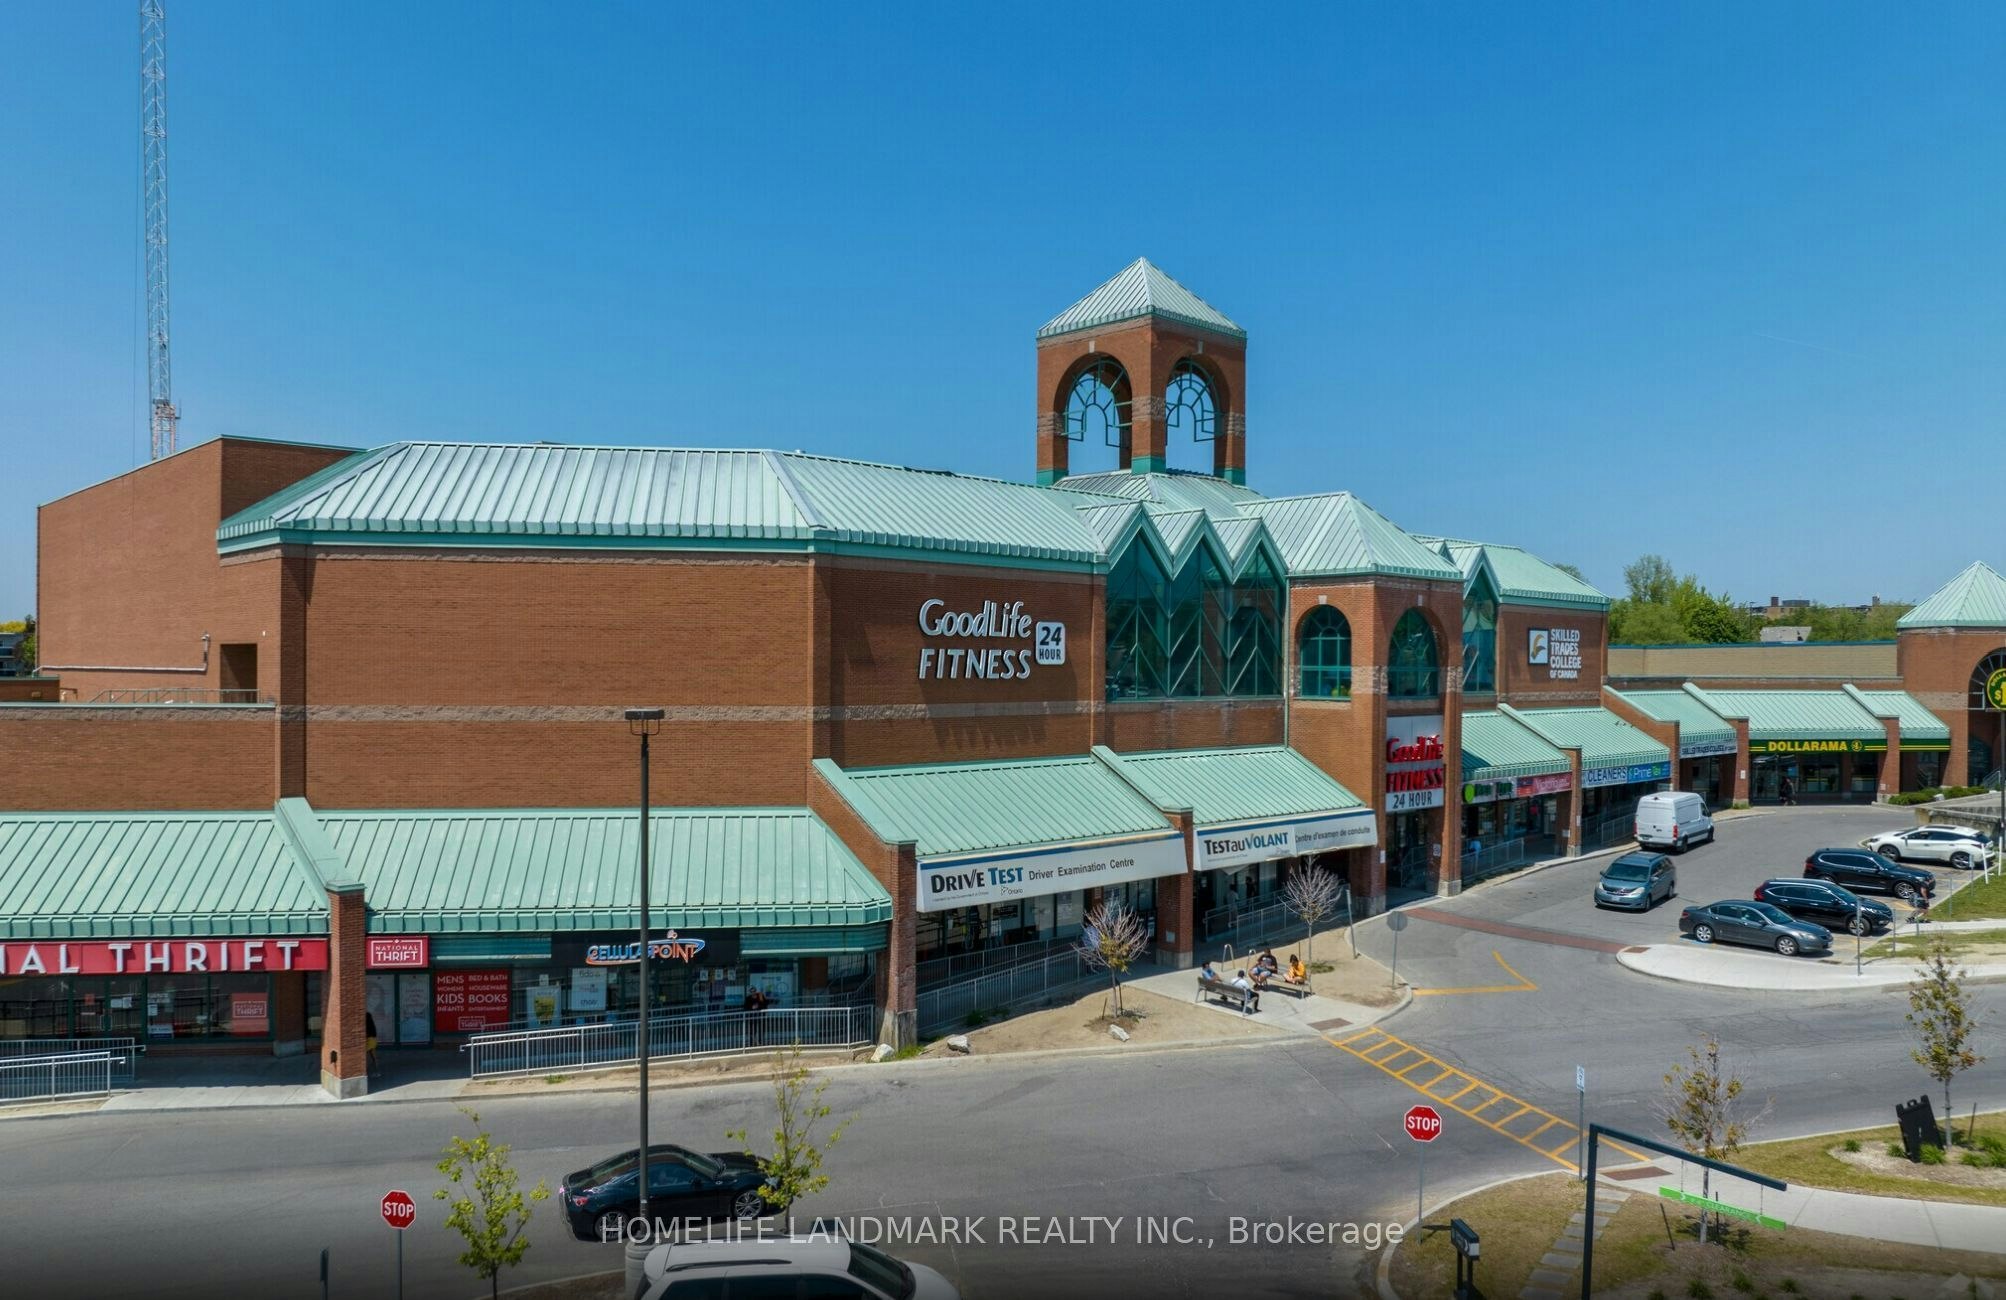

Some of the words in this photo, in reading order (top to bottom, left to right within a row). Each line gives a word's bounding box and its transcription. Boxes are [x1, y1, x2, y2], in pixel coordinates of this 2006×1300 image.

[919, 599, 1032, 638] GoodLife
[1039, 626, 1062, 646] 24
[1550, 629, 1580, 642] SKILLED
[1039, 648, 1061, 660] HOUR
[1550, 642, 1579, 655] TRADES
[919, 648, 1032, 679] FITNESS
[1550, 656, 1582, 668] COLLEGE
[1768, 741, 1848, 752] DOLLARAMA
[1588, 766, 1627, 782] CLEANERS
[1393, 794, 1405, 809] 24
[1409, 791, 1433, 807] HOUR
[988, 867, 1023, 885] TEST
[1029, 870, 1054, 880] Driver
[1058, 861, 1106, 876] Examination
[1110, 858, 1134, 869] Centre
[0, 944, 79, 974] AL
[108, 941, 299, 973] THRIFT
[376, 951, 418, 961] THRIFT
[437, 976, 464, 984] MENS
[436, 993, 464, 1004] KIDS
[468, 993, 508, 1003] BOOKS
[1407, 1115, 1439, 1131] STOP
[384, 1201, 414, 1218] STOP
